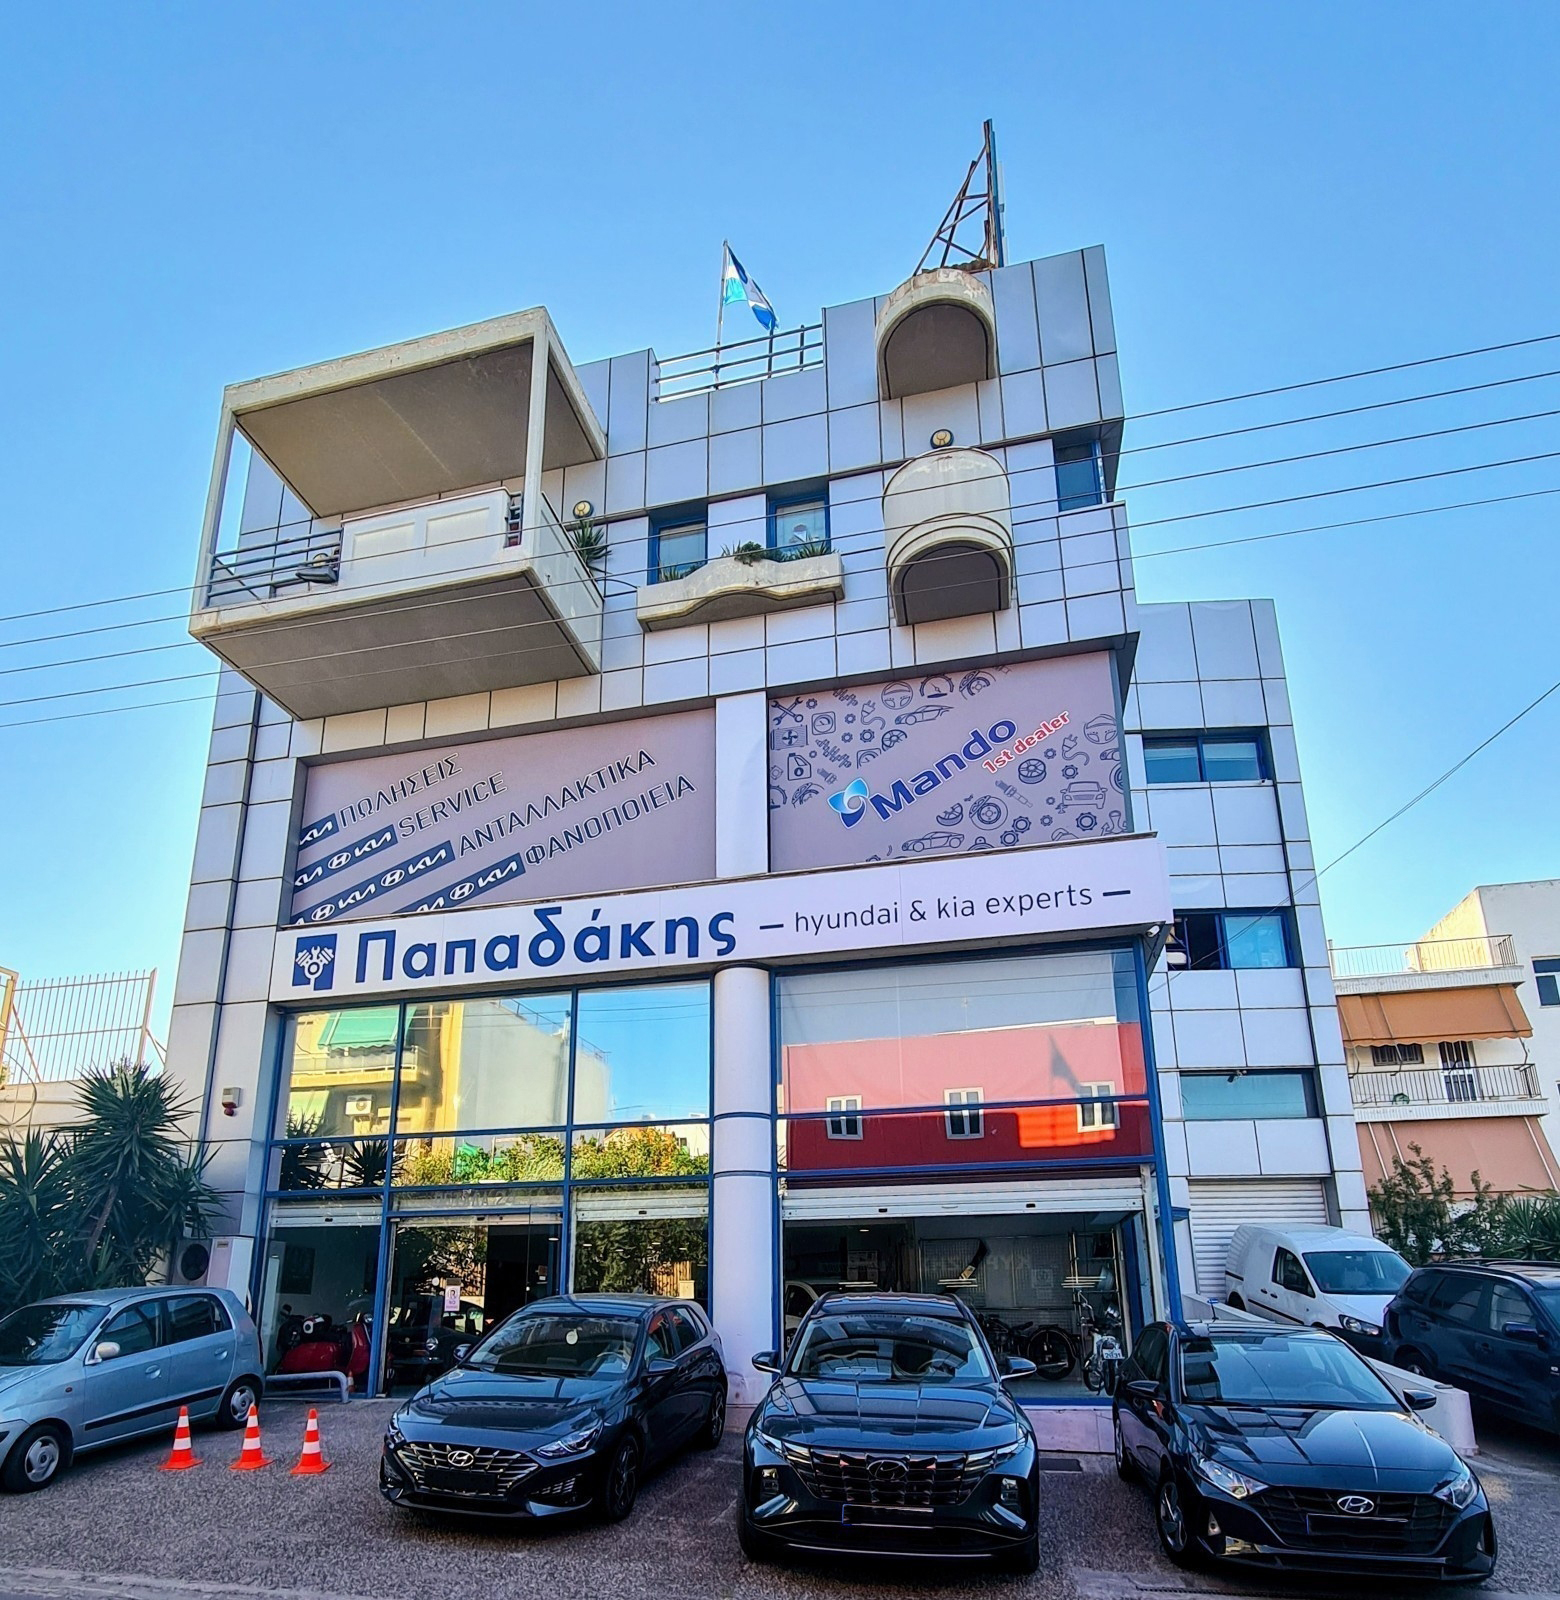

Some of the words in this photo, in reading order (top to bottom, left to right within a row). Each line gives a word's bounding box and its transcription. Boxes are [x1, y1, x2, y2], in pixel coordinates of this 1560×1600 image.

[868, 720, 1017, 821] Mando
[982, 749, 1014, 773] 1st
[1013, 711, 1070, 755] dealer
[340, 753, 462, 828] ΠΩΛΗΣΕΙΣ
[399, 771, 507, 838] SERVICE
[459, 749, 657, 857] ΑΝΤΑΛΛΑΚΤΙΚΑ
[525, 775, 697, 864] ΦΑΝΟΠΟΙΕΙΑ
[355, 906, 737, 984] Παπαδάκης
[795, 901, 899, 936] hyundai
[908, 899, 927, 922] &
[937, 897, 975, 919] kia
[985, 884, 1093, 916] experts
